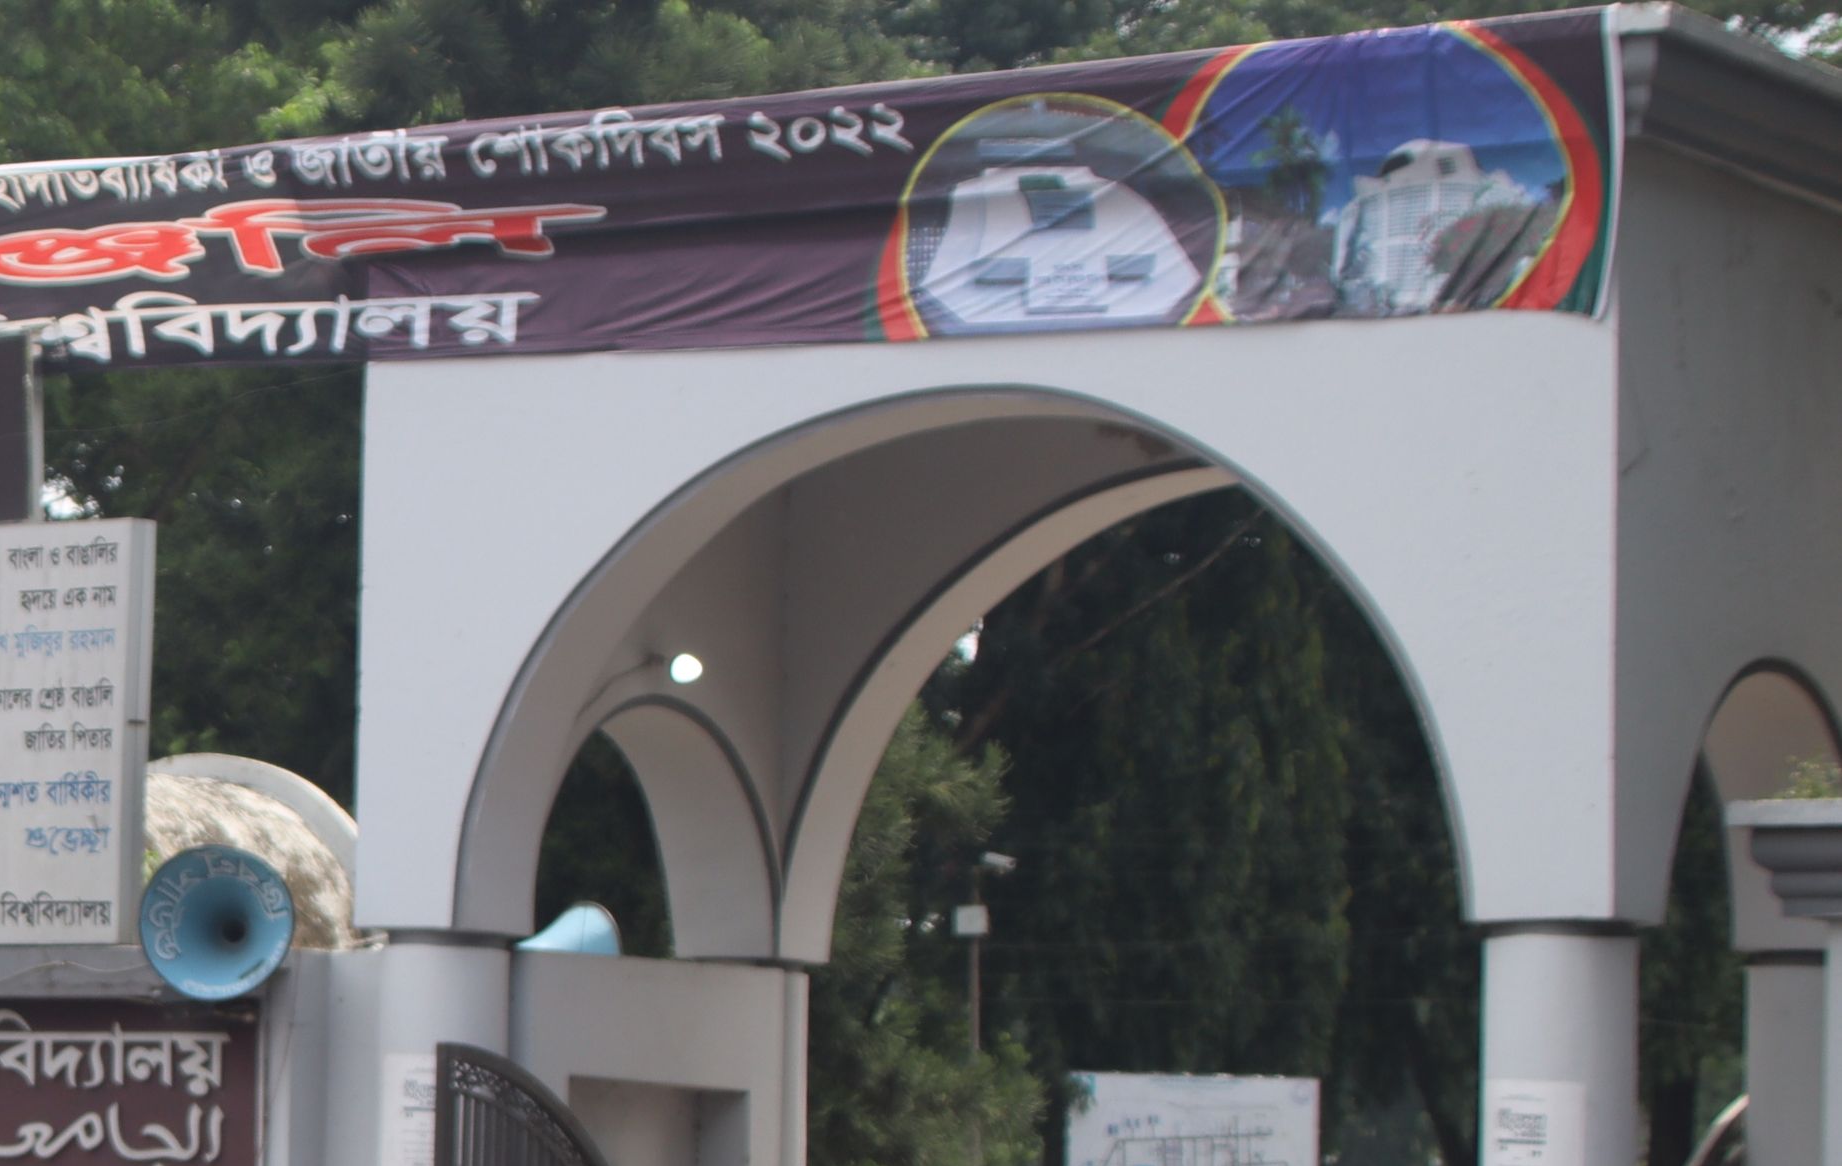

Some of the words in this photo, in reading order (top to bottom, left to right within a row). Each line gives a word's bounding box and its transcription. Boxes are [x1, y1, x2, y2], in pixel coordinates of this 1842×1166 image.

[243, 149, 278, 188] ও
[290, 128, 449, 188] জাতীয়
[465, 109, 725, 178] শোকদিবস
[747, 102, 915, 162] ২০২২
[7, 546, 43, 571] বাংলা
[49, 549, 60, 567] ও
[63, 587, 87, 607] এক
[92, 585, 116, 606] নাম
[15, 624, 62, 659] মুজিবুর
[69, 627, 115, 653] রহমান
[24, 723, 66, 752] জাতির
[72, 722, 112, 751] পিতার
[46, 769, 111, 806] বার্ষিকীর
[25, 823, 111, 856] শুভেচ্ছা
[0, 890, 112, 929] বিশ্ববিদ্যালয়
